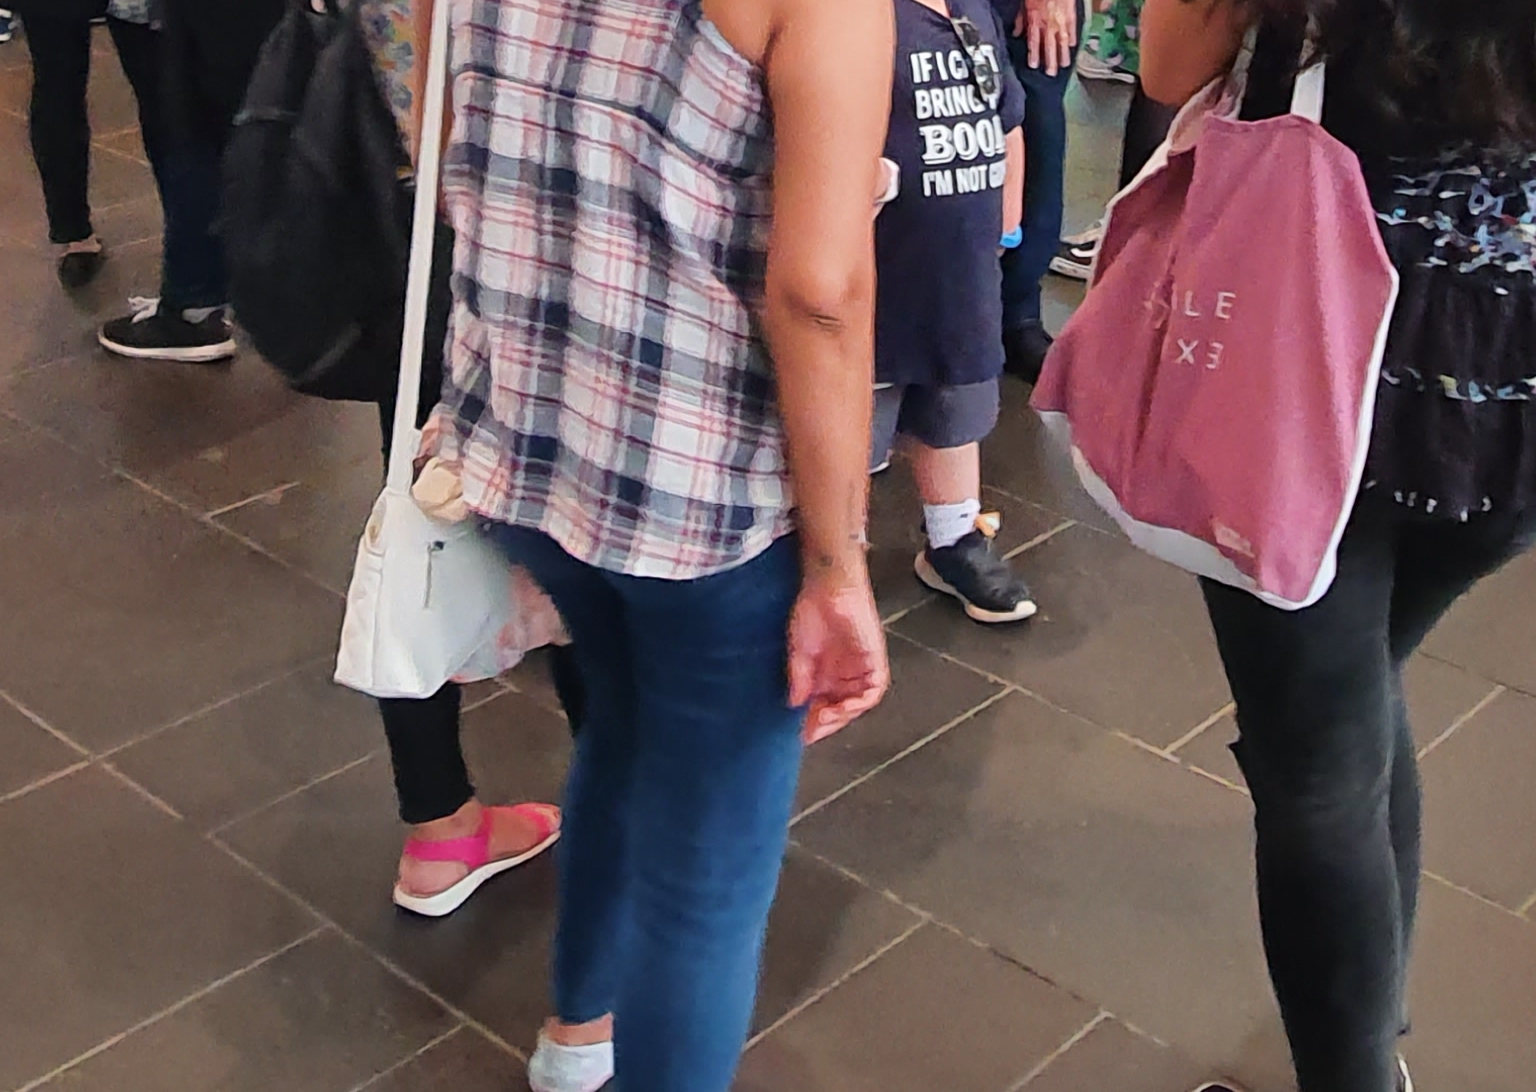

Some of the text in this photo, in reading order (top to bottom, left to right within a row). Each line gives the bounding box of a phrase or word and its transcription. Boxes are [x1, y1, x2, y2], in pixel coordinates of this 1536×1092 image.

[910, 51, 934, 83] IF
[935, 50, 949, 81] I
[922, 169, 954, 197] I'M
[956, 163, 989, 194] NOT
